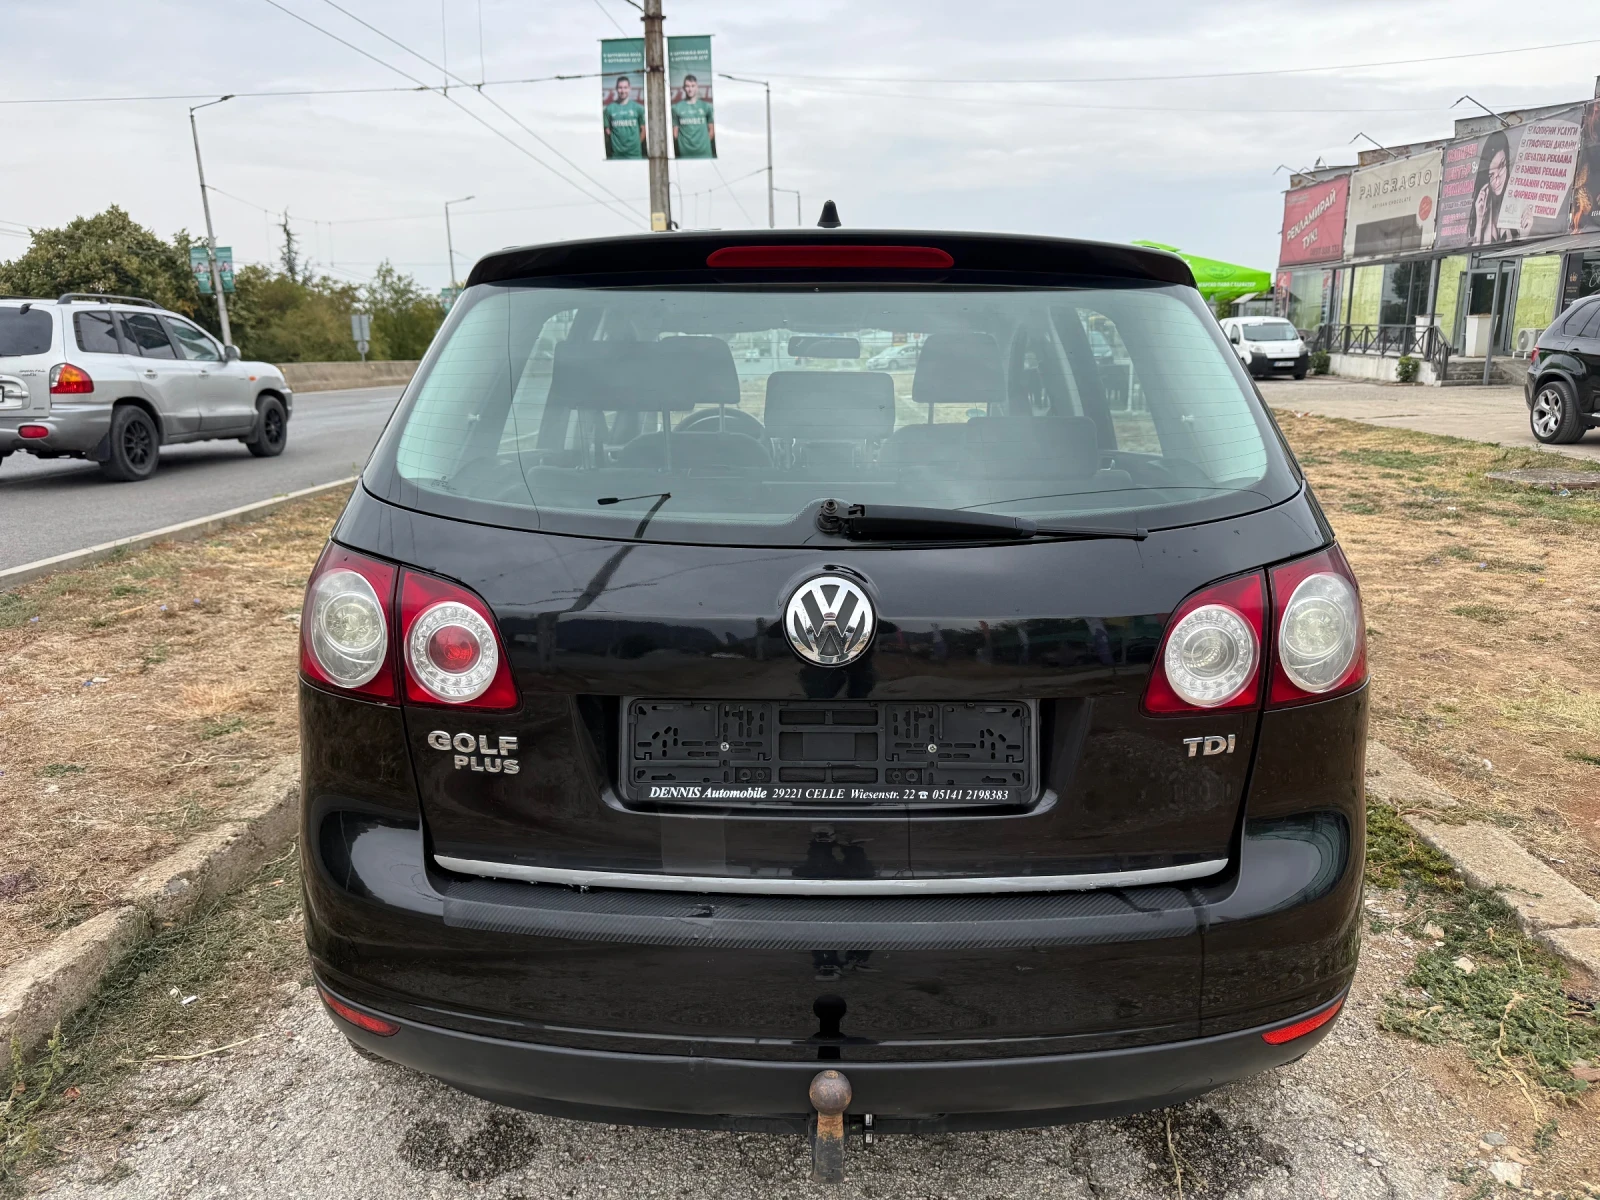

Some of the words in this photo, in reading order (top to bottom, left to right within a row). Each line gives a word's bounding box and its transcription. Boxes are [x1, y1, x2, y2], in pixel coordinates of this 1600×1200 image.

[1546, 153, 1573, 164] РЕКЛАМА
[1542, 166, 1567, 178] РЕКЛАМА
[1359, 169, 1432, 200] PANCRACIO
[1540, 180, 1567, 191] СУВЕНИРИ
[1287, 187, 1336, 242] РЕКЛАМИРАЙ
[1302, 228, 1318, 249] ТУК!
[427, 730, 519, 756] GOLF
[1183, 734, 1236, 757] TDI
[453, 754, 520, 775] PLUS
[649, 787, 702, 798] DENNIS
[702, 787, 768, 799] Automobile
[772, 788, 802, 799] 29221
[805, 788, 846, 799] CELLE
[850, 789, 900, 800] Wiesenstr.
[902, 789, 916, 799] 22
[932, 789, 963, 800] 05141
[965, 790, 1009, 800] 2198383
